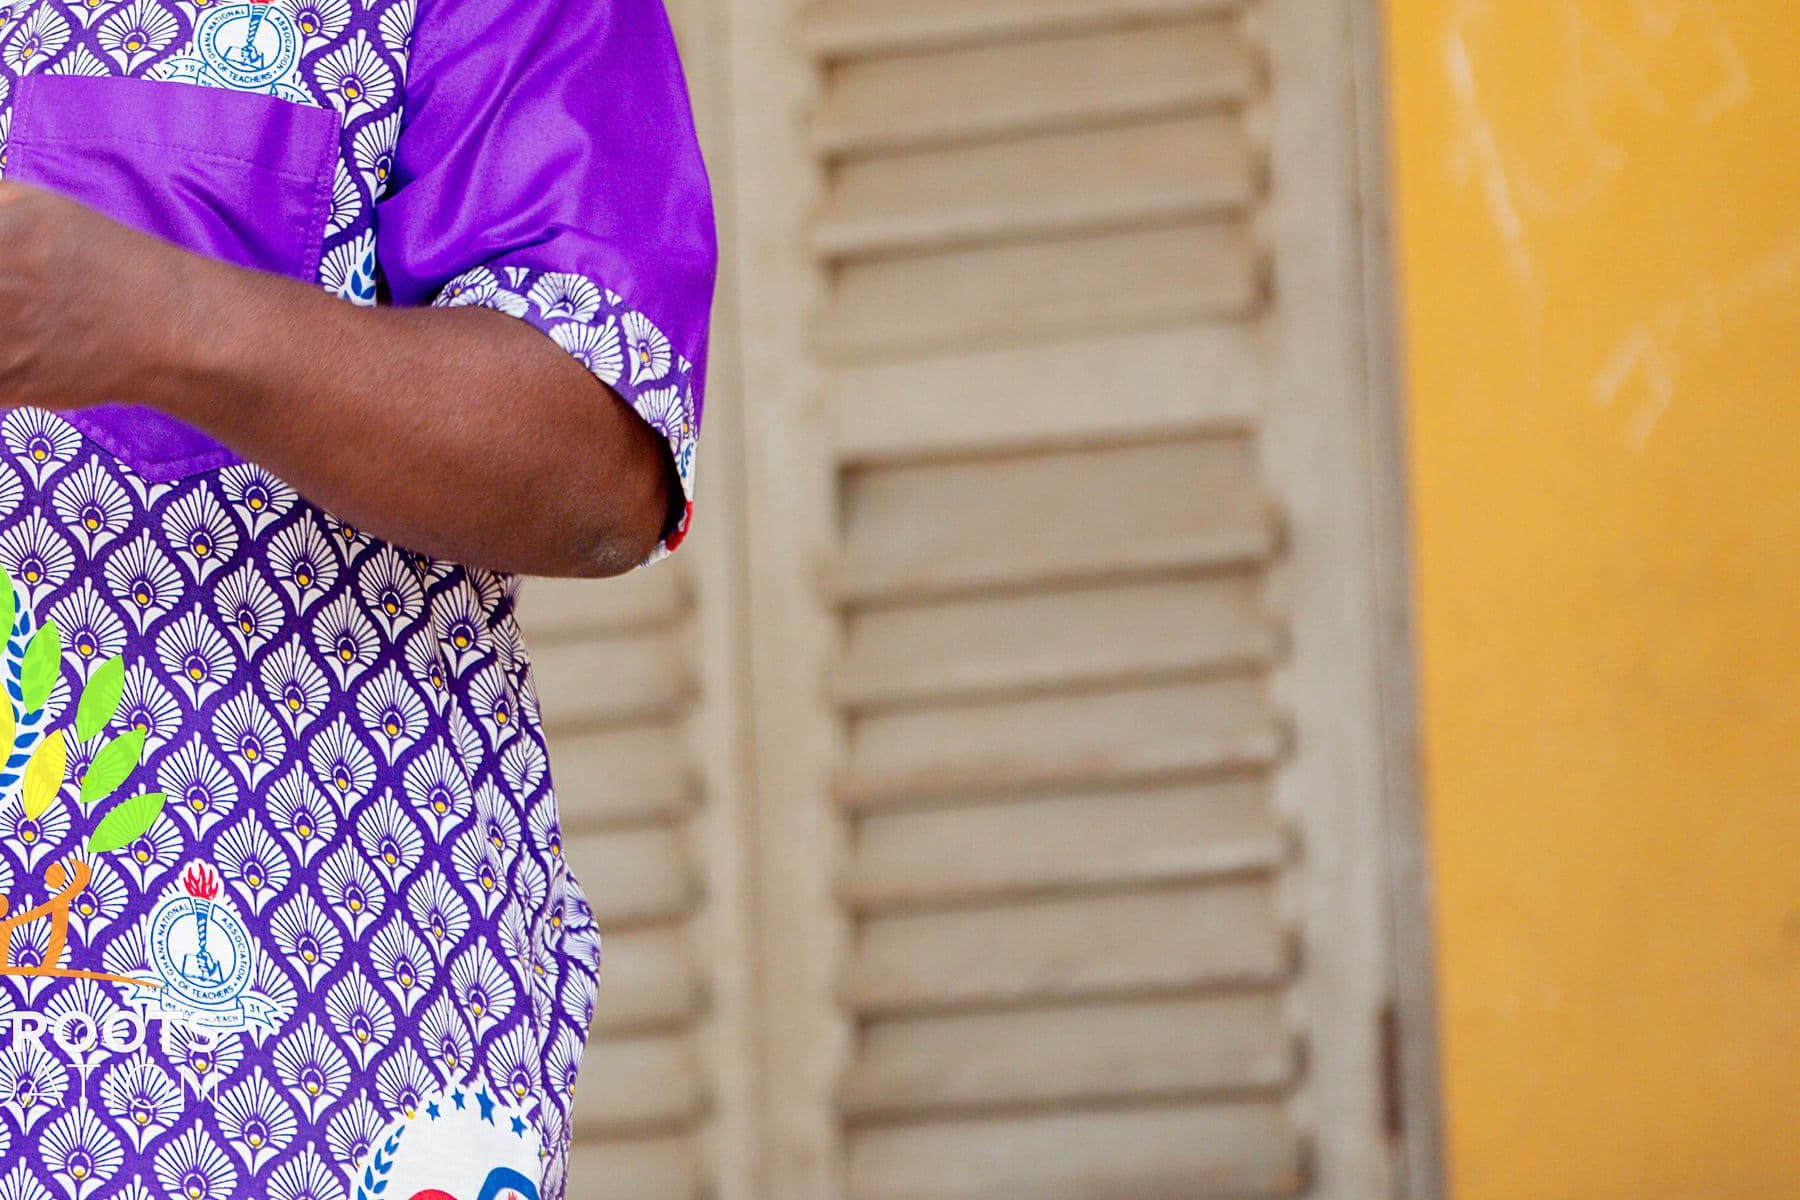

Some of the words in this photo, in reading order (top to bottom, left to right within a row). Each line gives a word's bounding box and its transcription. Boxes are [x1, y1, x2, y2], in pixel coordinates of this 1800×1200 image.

[207, 9, 245, 31] NATIONAL
[275, 16, 292, 71] ASSOCIATION
[229, 71, 273, 83] TEACHERS
[158, 903, 190, 936] NATIONAL
[157, 940, 174, 976] GHANA
[222, 917, 247, 983] ASSOCIATION
[178, 980, 190, 990] OF
[192, 987, 234, 1000] TEACHERS
[249, 1004, 260, 1013] 31
